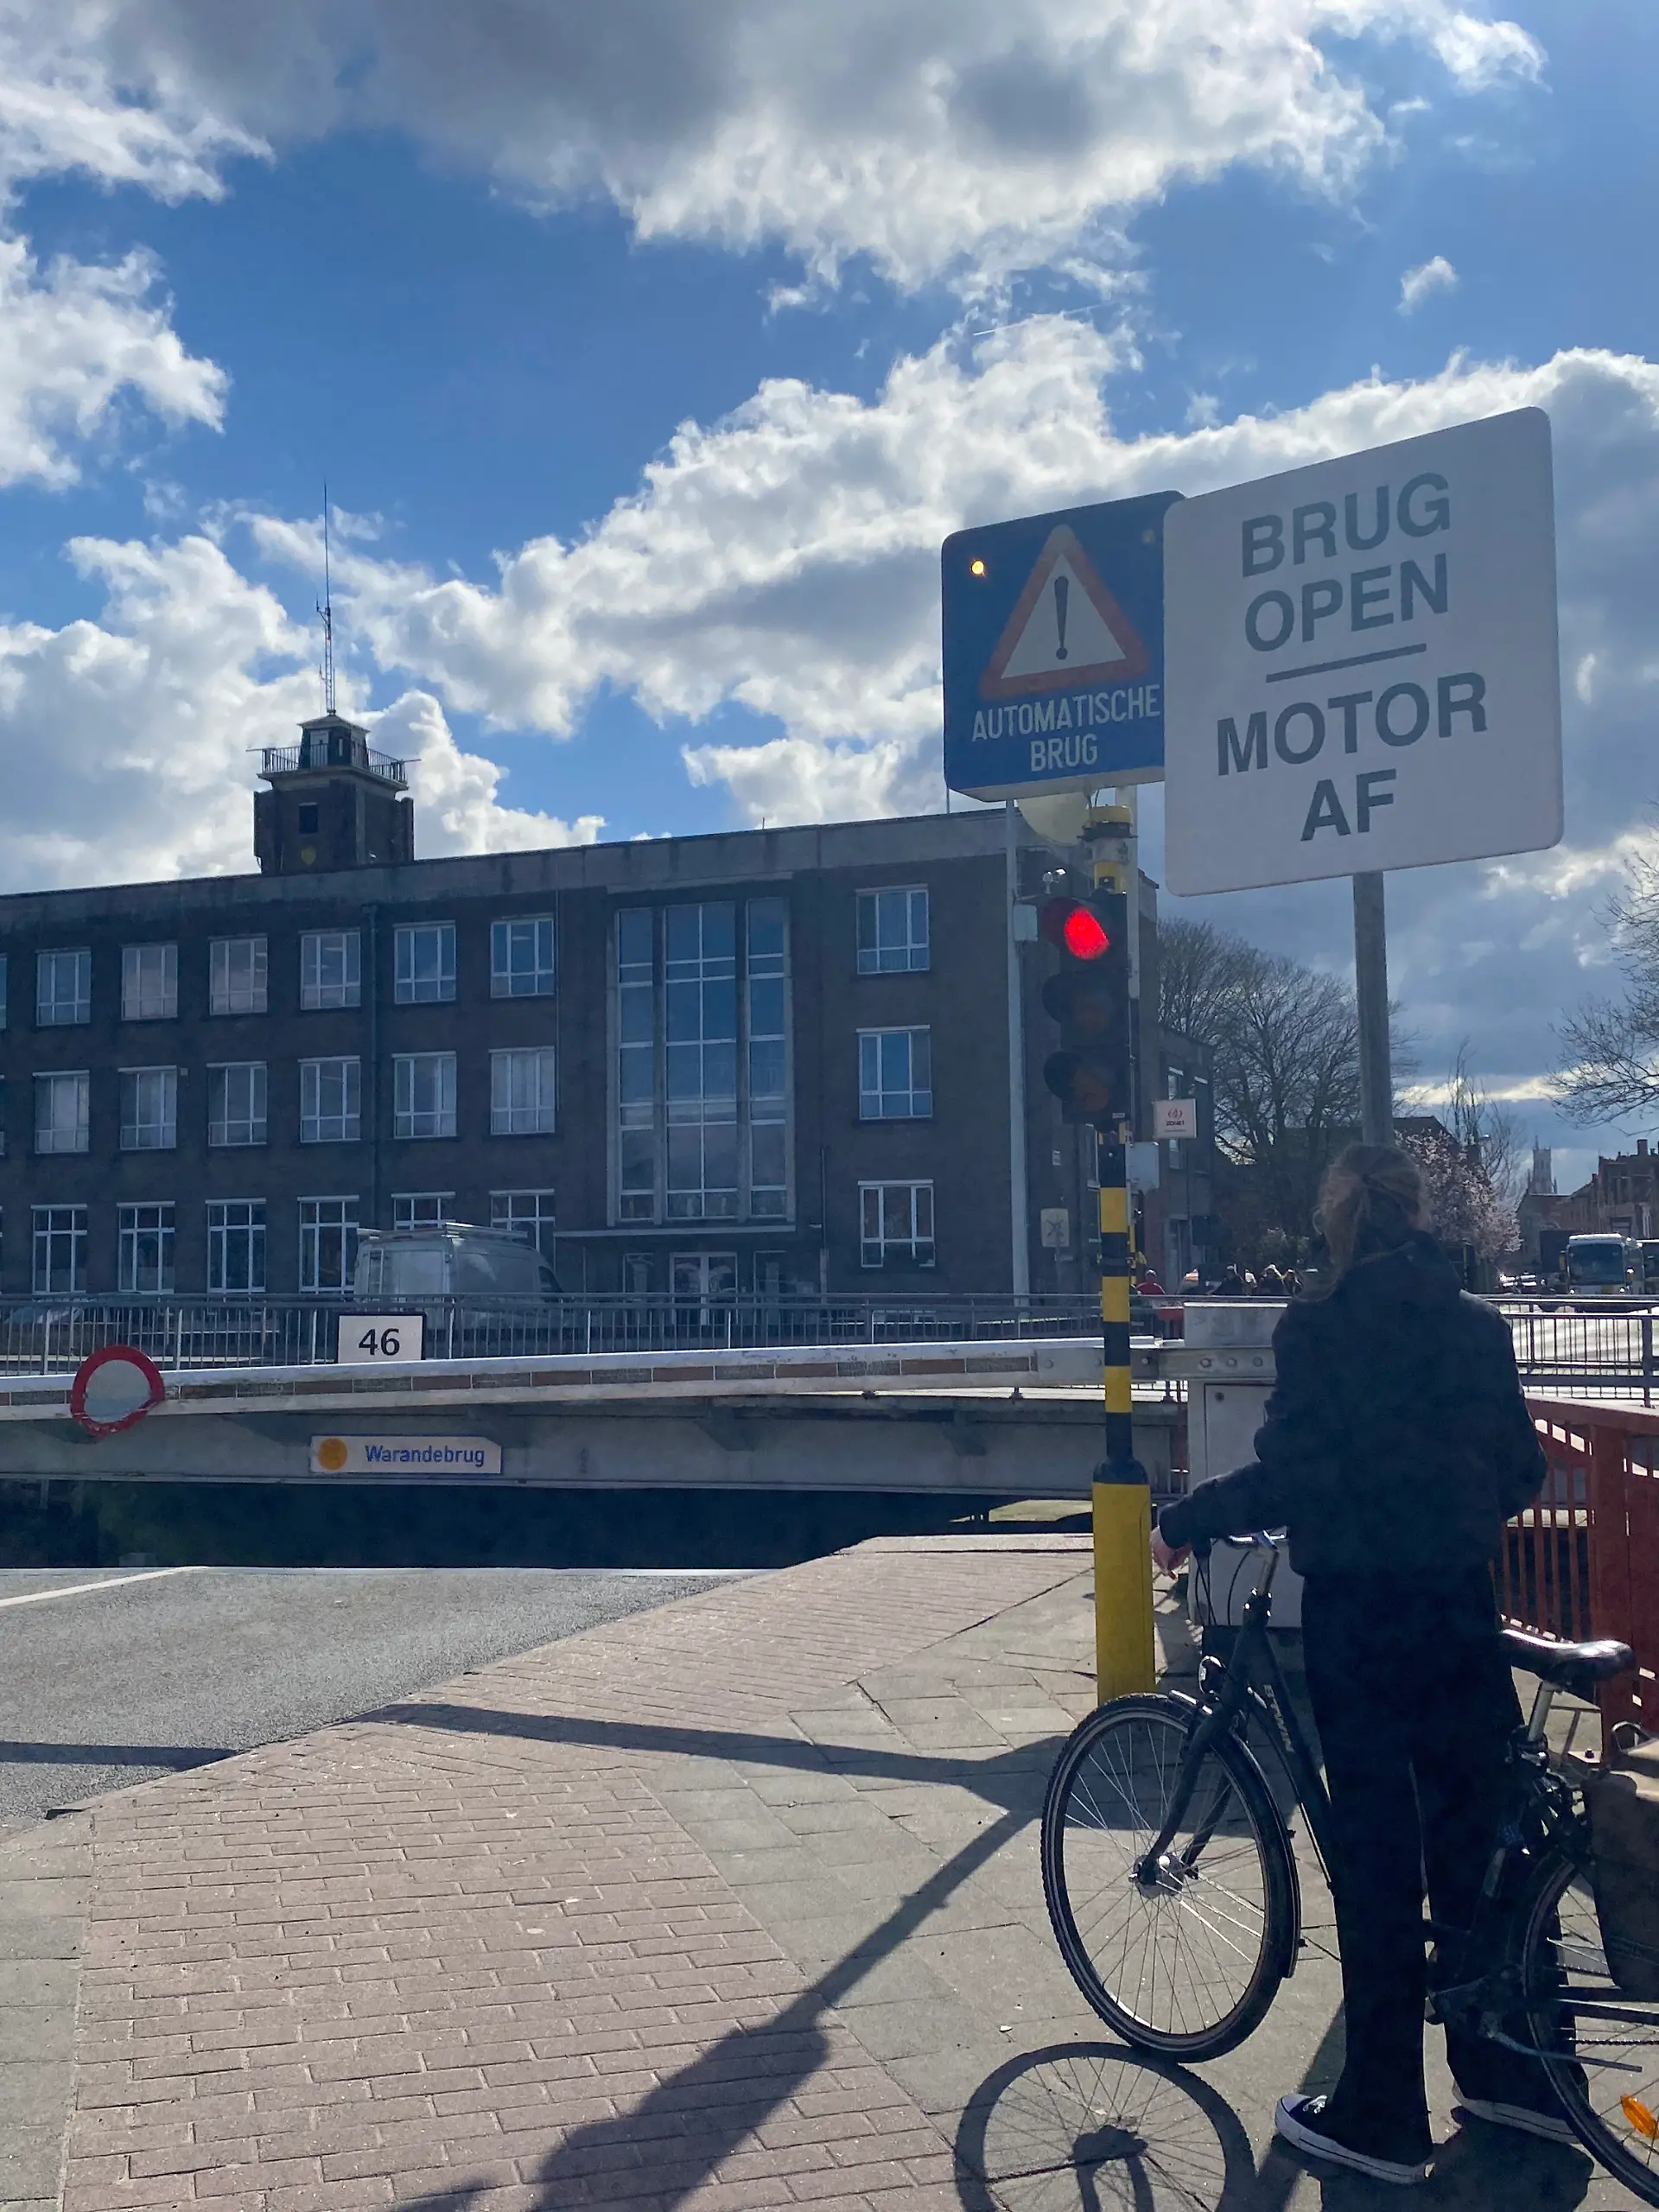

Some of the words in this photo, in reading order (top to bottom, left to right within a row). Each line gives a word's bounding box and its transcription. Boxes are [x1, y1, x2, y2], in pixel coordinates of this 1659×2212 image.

[1241, 472, 1451, 578] BRUG
[1244, 552, 1449, 652] OPEN
[970, 683, 1161, 742] AUTOMATISCHE
[1217, 671, 1488, 776] MOTOR
[1029, 733, 1098, 772] BRUG
[1300, 767, 1397, 842] AF
[358, 1327, 400, 1356] 46
[364, 1445, 486, 1468] Warandebrug
